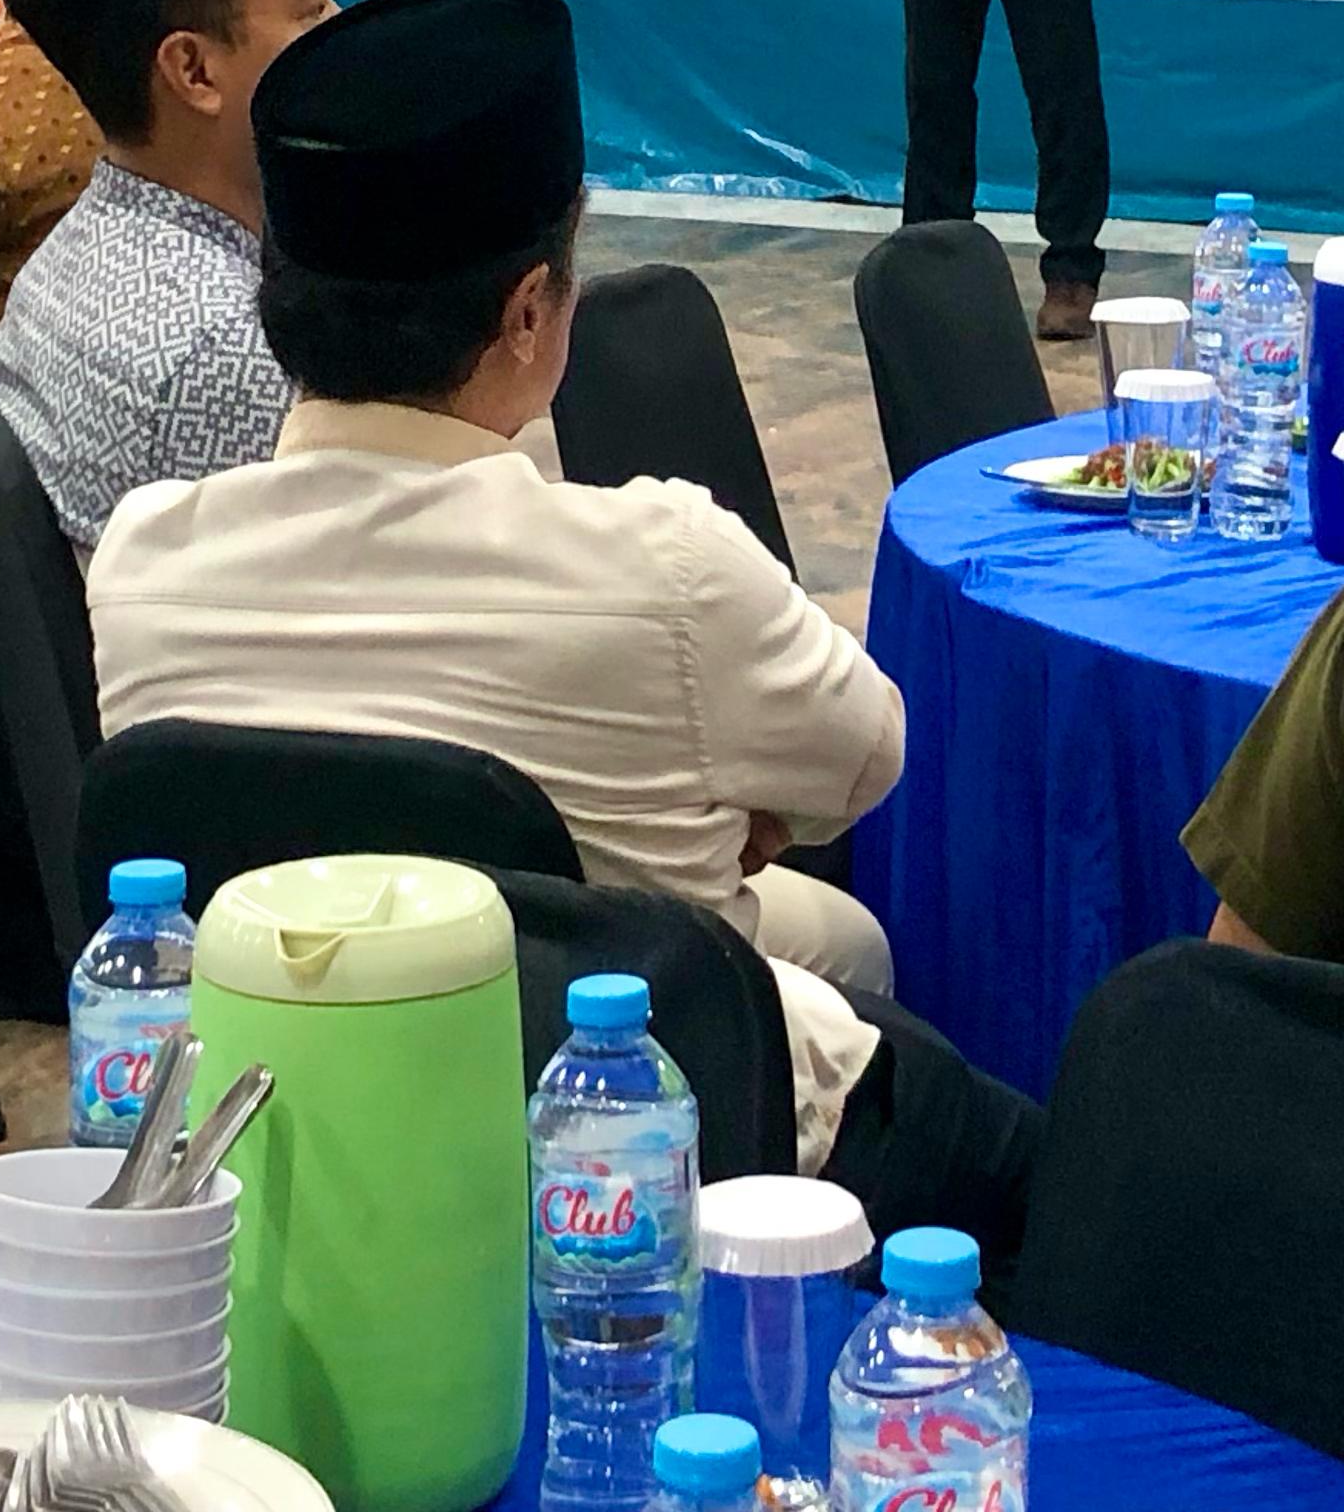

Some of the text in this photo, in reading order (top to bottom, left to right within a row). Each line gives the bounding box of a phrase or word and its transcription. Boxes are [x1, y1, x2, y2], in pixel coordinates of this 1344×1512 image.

[1244, 337, 1296, 364] Club
[95, 1050, 154, 1100] Cl
[540, 1183, 636, 1236] Club
